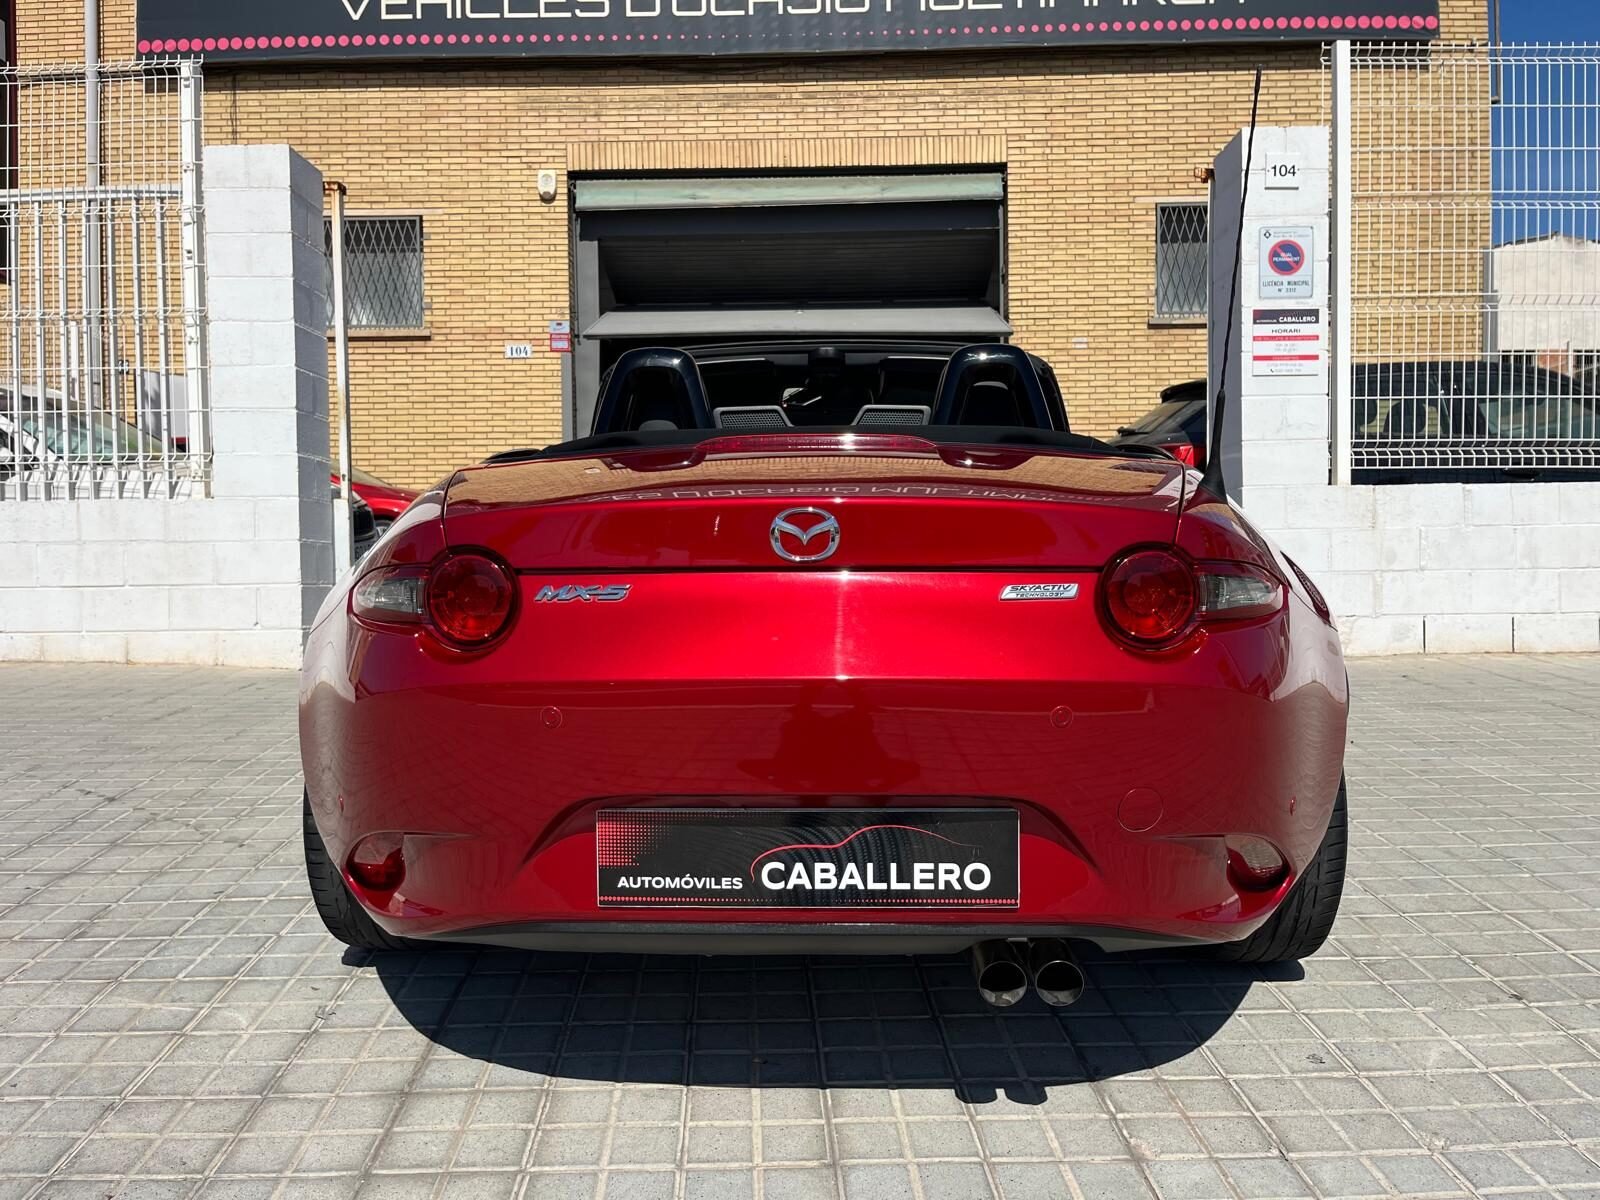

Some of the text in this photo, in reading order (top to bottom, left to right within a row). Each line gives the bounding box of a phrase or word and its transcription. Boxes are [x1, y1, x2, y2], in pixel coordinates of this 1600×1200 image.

[340, 0, 610, 20] VEHICLES
[1271, 164, 1297, 177] 104
[510, 346, 528, 356] 104
[534, 585, 632, 602] MX-5
[617, 861, 992, 891] AUTOMÓVILES CABALLERO
